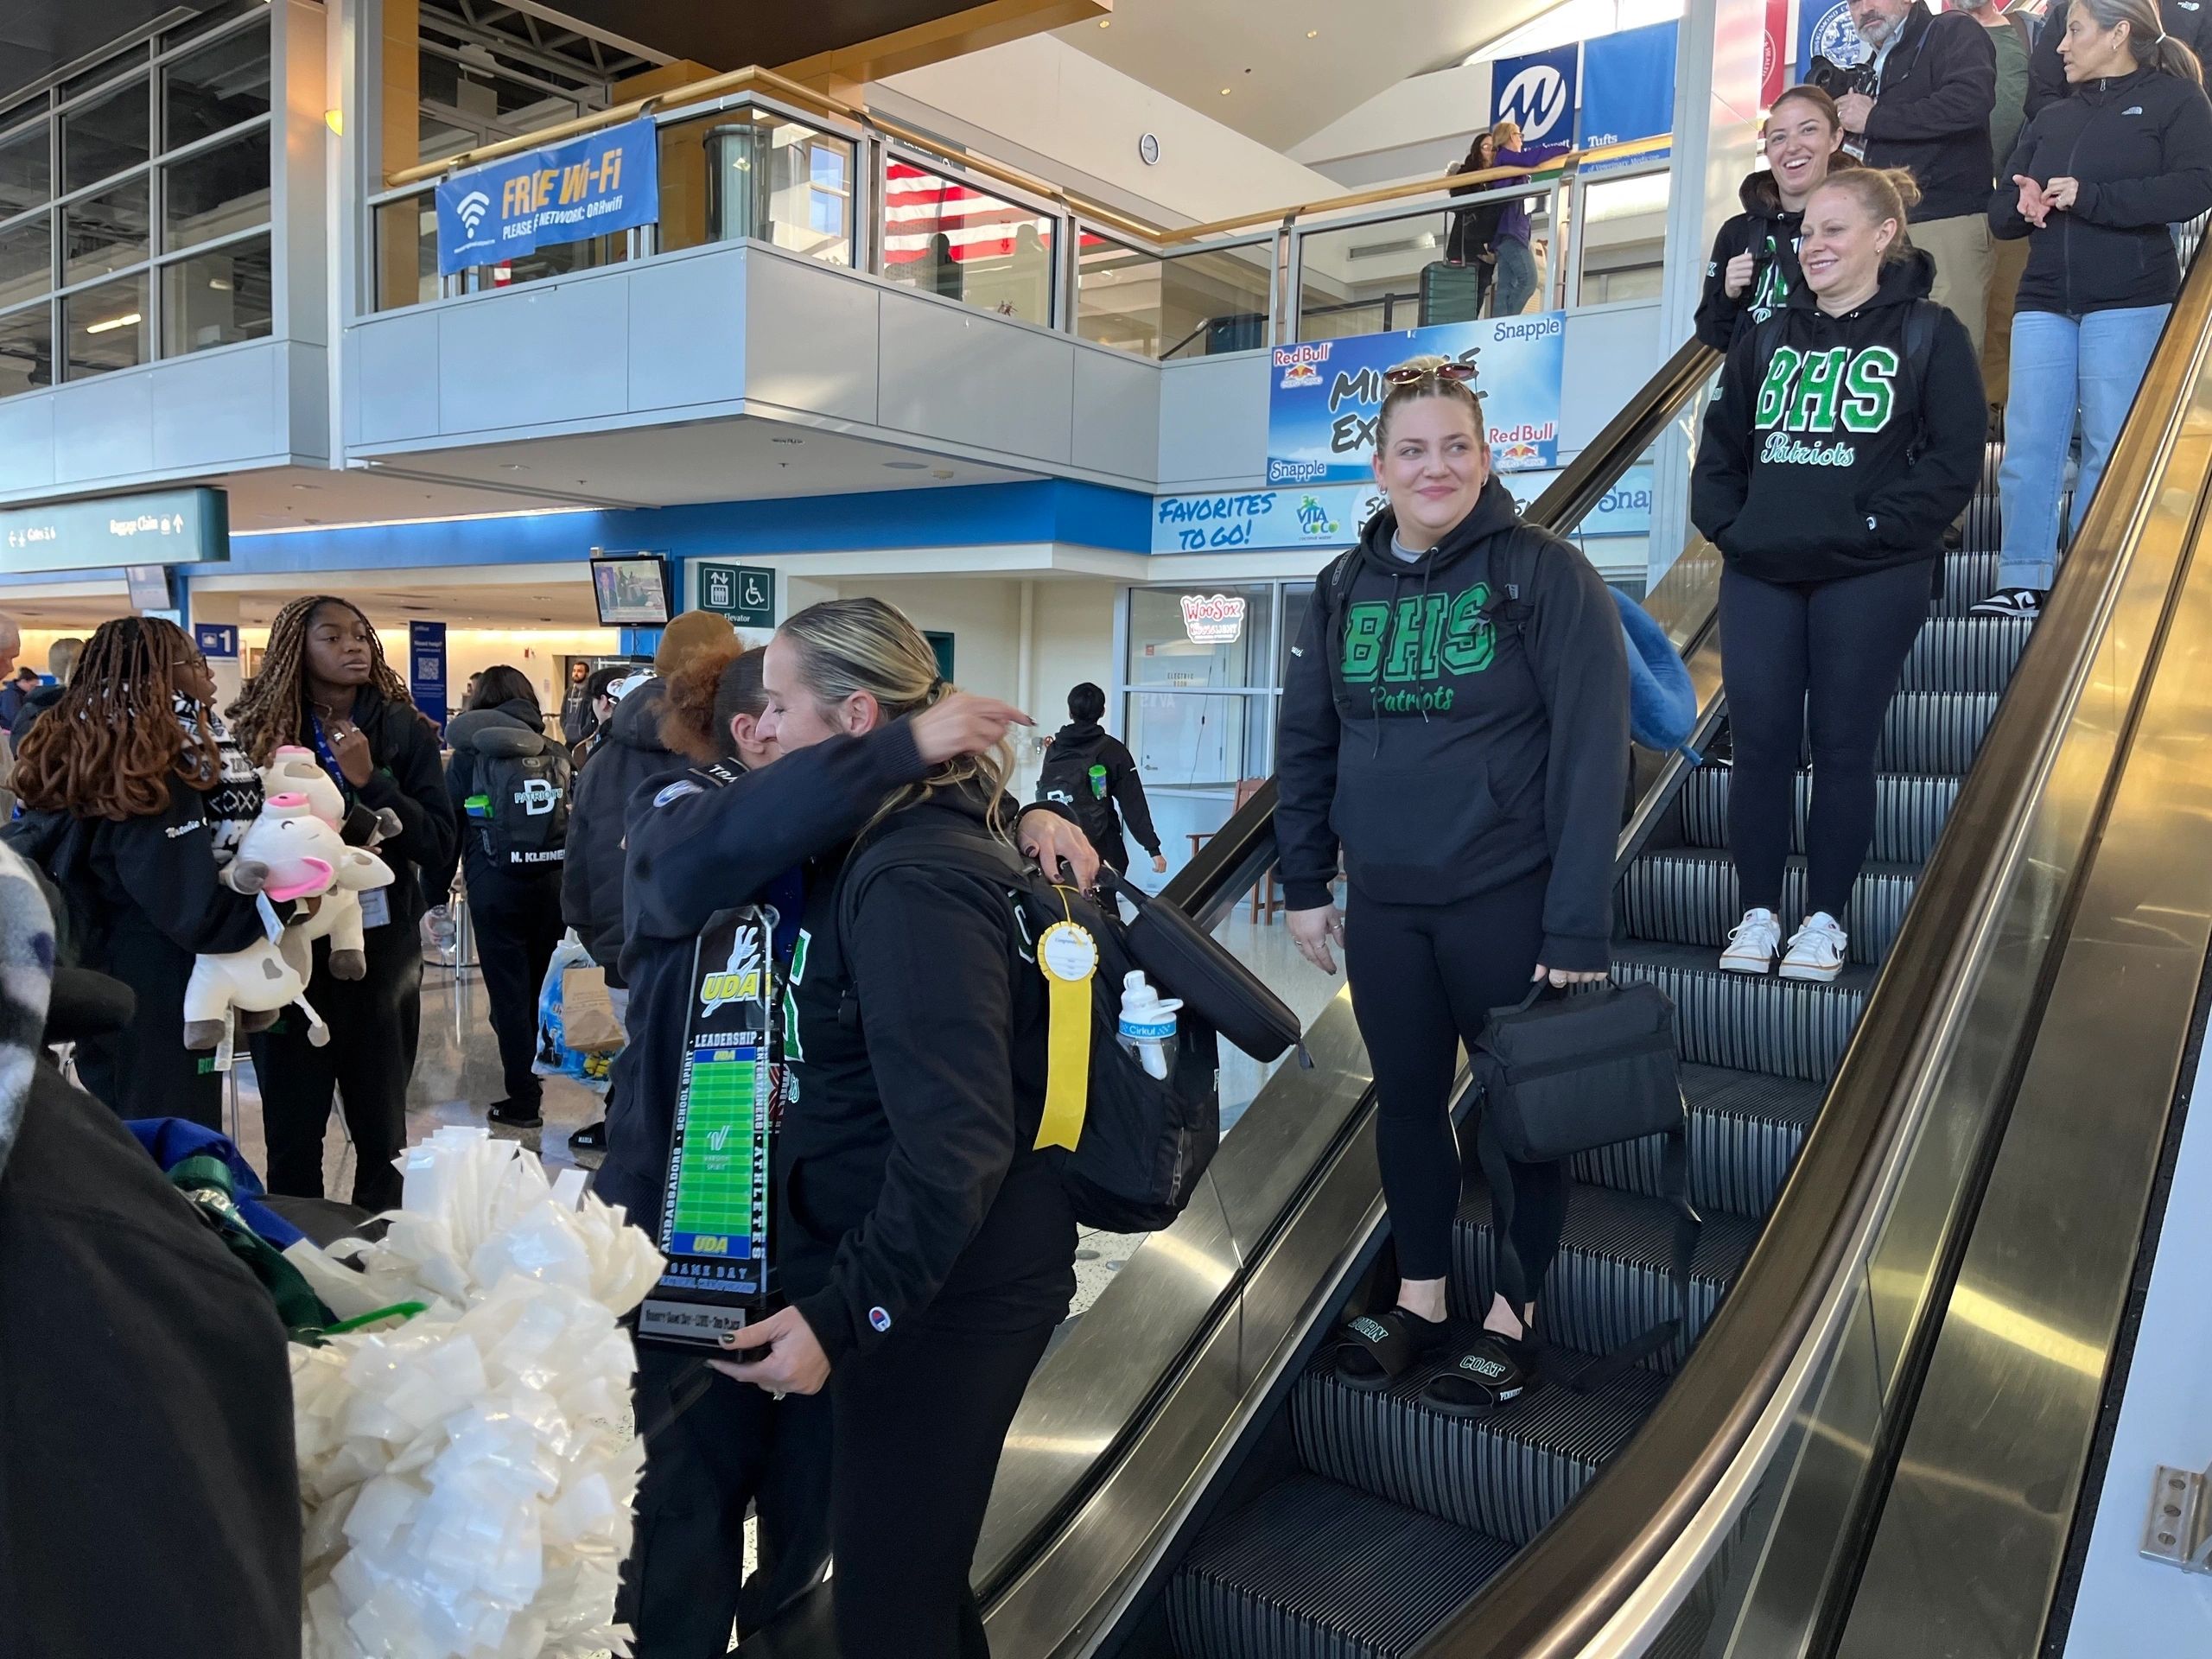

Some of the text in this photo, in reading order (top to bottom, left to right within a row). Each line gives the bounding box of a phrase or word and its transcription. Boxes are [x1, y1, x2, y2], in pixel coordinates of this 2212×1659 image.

[1587, 133, 1618, 148] Tufts
[503, 220, 532, 240] PLEASE
[1494, 318, 1560, 343] Snapple
[1274, 344, 1328, 365] Red Bull
[1755, 346, 1899, 433] BHS
[1489, 423, 1554, 444] Red Bull
[1761, 431, 1854, 467] Patriots
[1270, 460, 1325, 481] Snapple
[1159, 492, 1277, 524] FAVORITES
[1296, 506, 1329, 524] VITA
[137, 515, 158, 532] Claim
[1179, 519, 1252, 550] TO GO!
[724, 613, 751, 622] Elevator
[219, 630, 231, 652] 1
[1341, 582, 1497, 683] BHS
[1370, 685, 1454, 711] Patriots
[514, 787, 563, 804] PATRIOTS
[524, 779, 555, 816] B
[511, 849, 566, 863] N. KLEINE
[702, 971, 760, 1002] UDA
[695, 1032, 758, 1048] LEADERSHIP
[1128, 1025, 1156, 1036] Cirkul
[661, 1051, 694, 1254] AMBASSADORS SCHOOL SPIRIT
[752, 1147, 764, 1259] ATHLETES
[692, 1236, 728, 1254] UDA
[670, 1262, 748, 1280] GAME DAY
[1348, 1316, 1389, 1343] BURN
[1459, 1355, 1506, 1378] COAT
